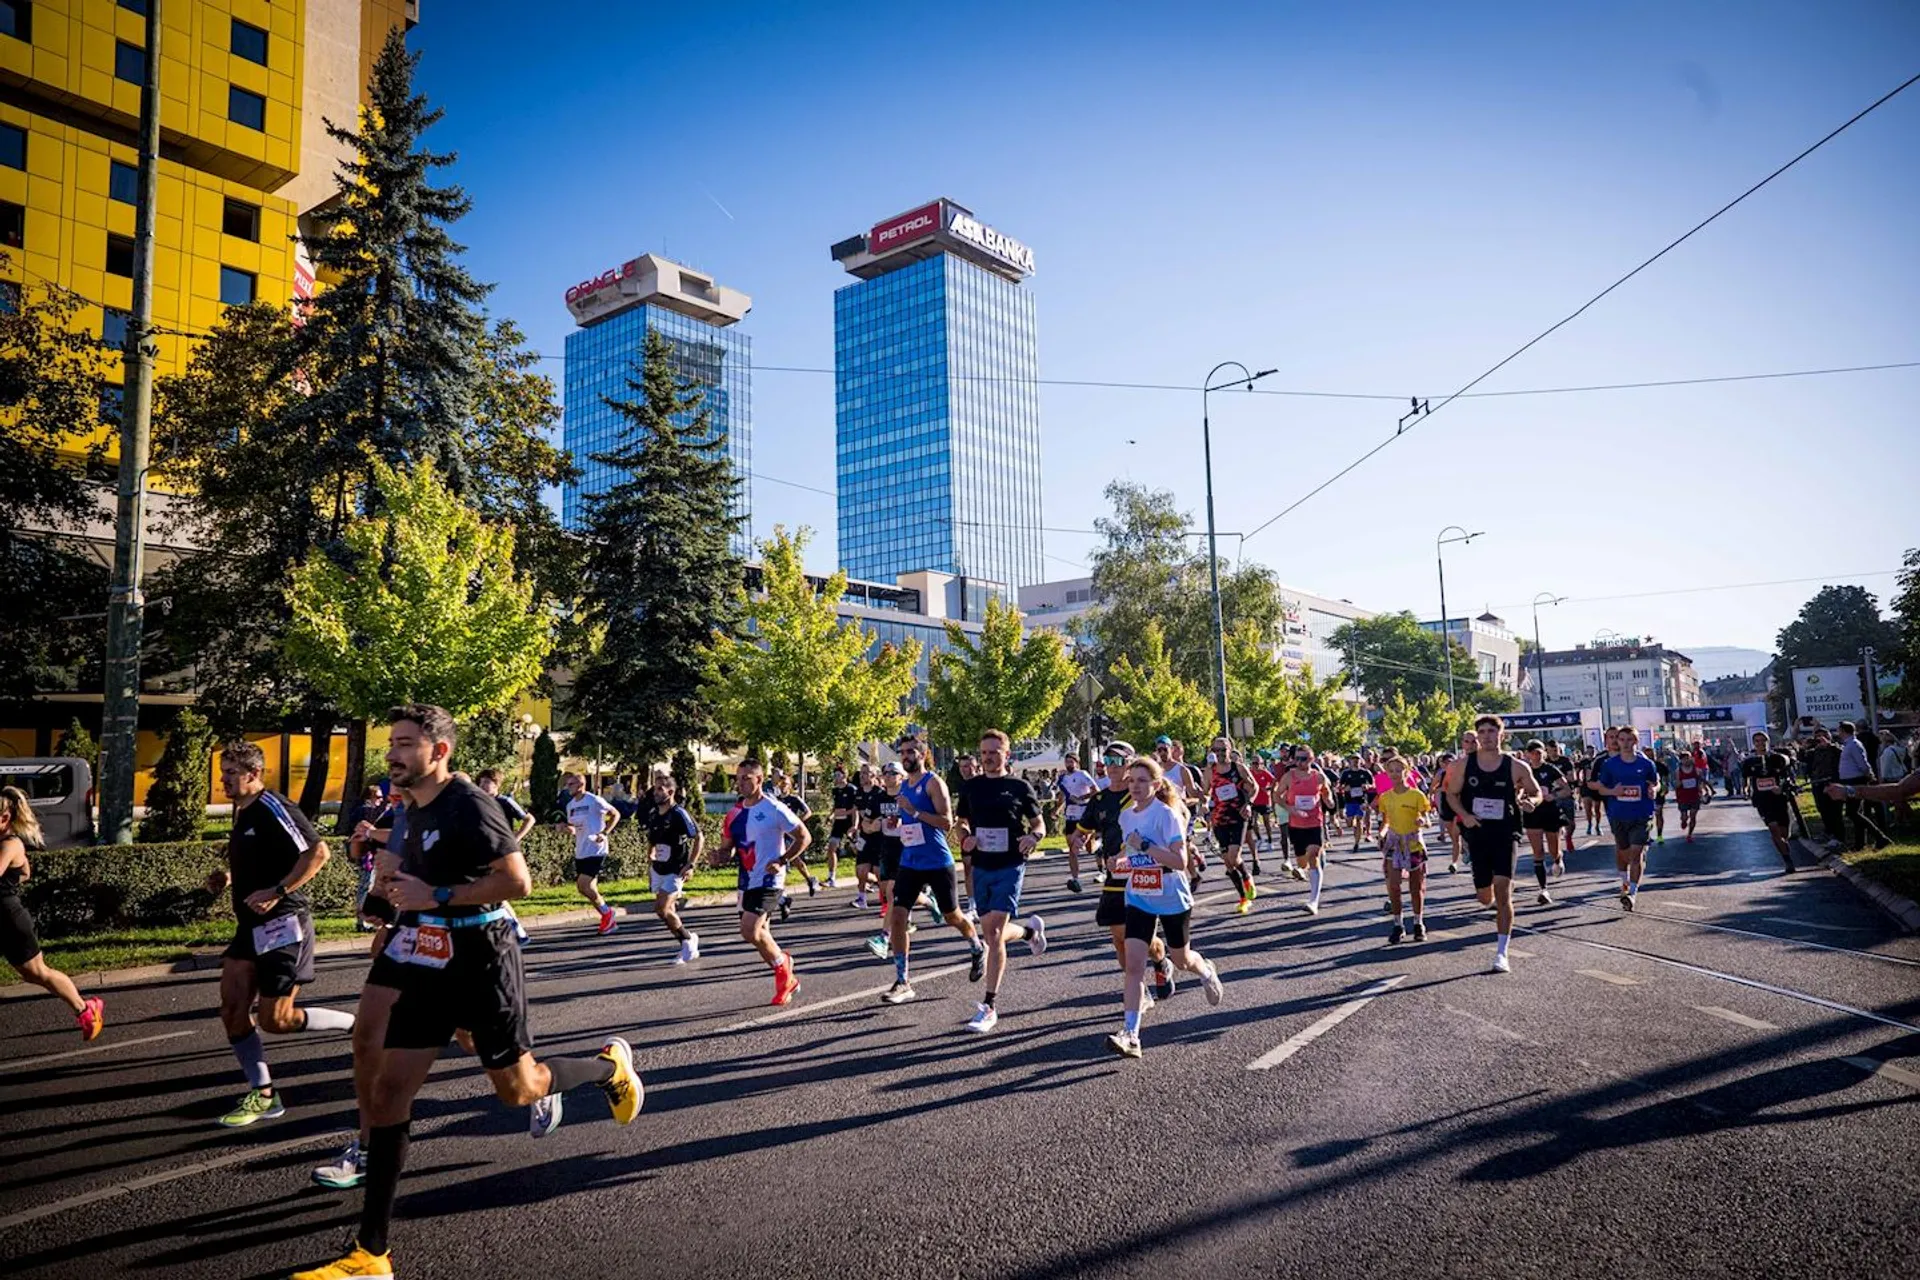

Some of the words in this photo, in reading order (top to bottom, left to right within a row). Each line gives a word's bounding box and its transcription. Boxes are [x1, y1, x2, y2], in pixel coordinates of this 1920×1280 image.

[879, 214, 933, 243] PETROL
[985, 227, 1035, 272] BANKA
[565, 260, 636, 304] ORACLE
